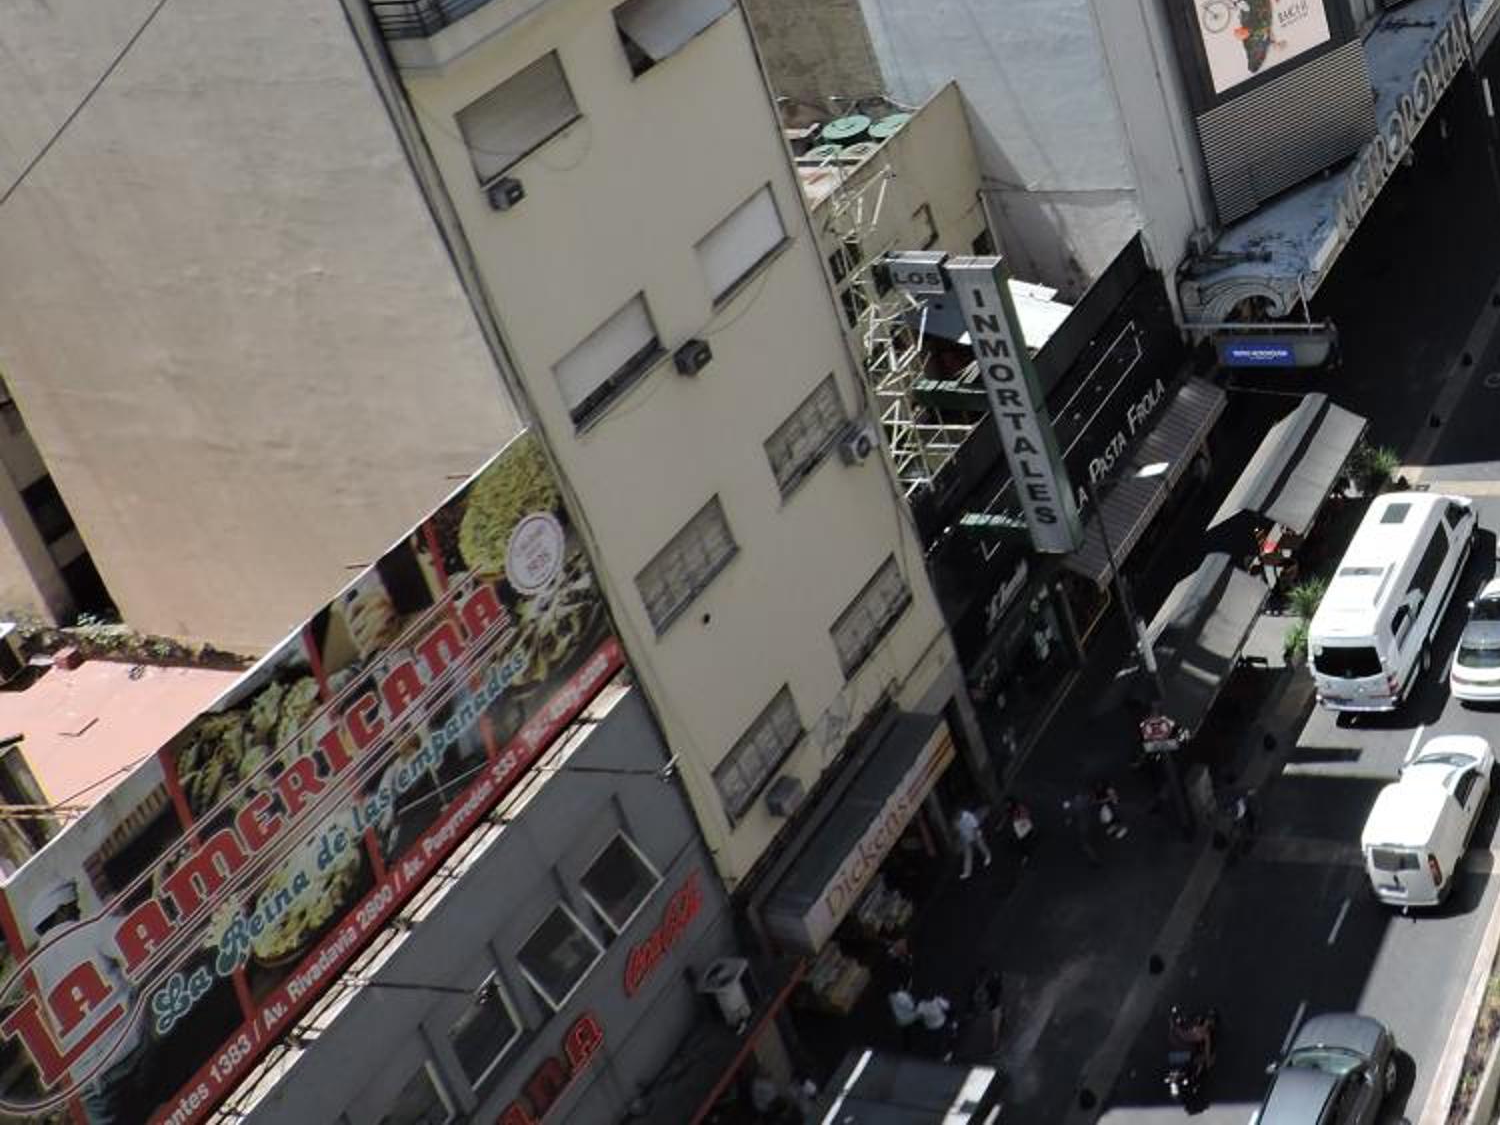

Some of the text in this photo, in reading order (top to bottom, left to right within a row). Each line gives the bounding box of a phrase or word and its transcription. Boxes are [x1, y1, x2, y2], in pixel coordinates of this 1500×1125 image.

[895, 272, 941, 286] LOS
[971, 289, 1058, 524] INMORTALES
[1, 960, 127, 1091] LA
[113, 583, 507, 977] AMERICANA
[216, 869, 310, 975] Reina
[317, 825, 349, 870] de
[394, 651, 529, 791] empanadas
[209, 1033, 251, 1083] 1383
[286, 926, 358, 1002] Rivadavia
